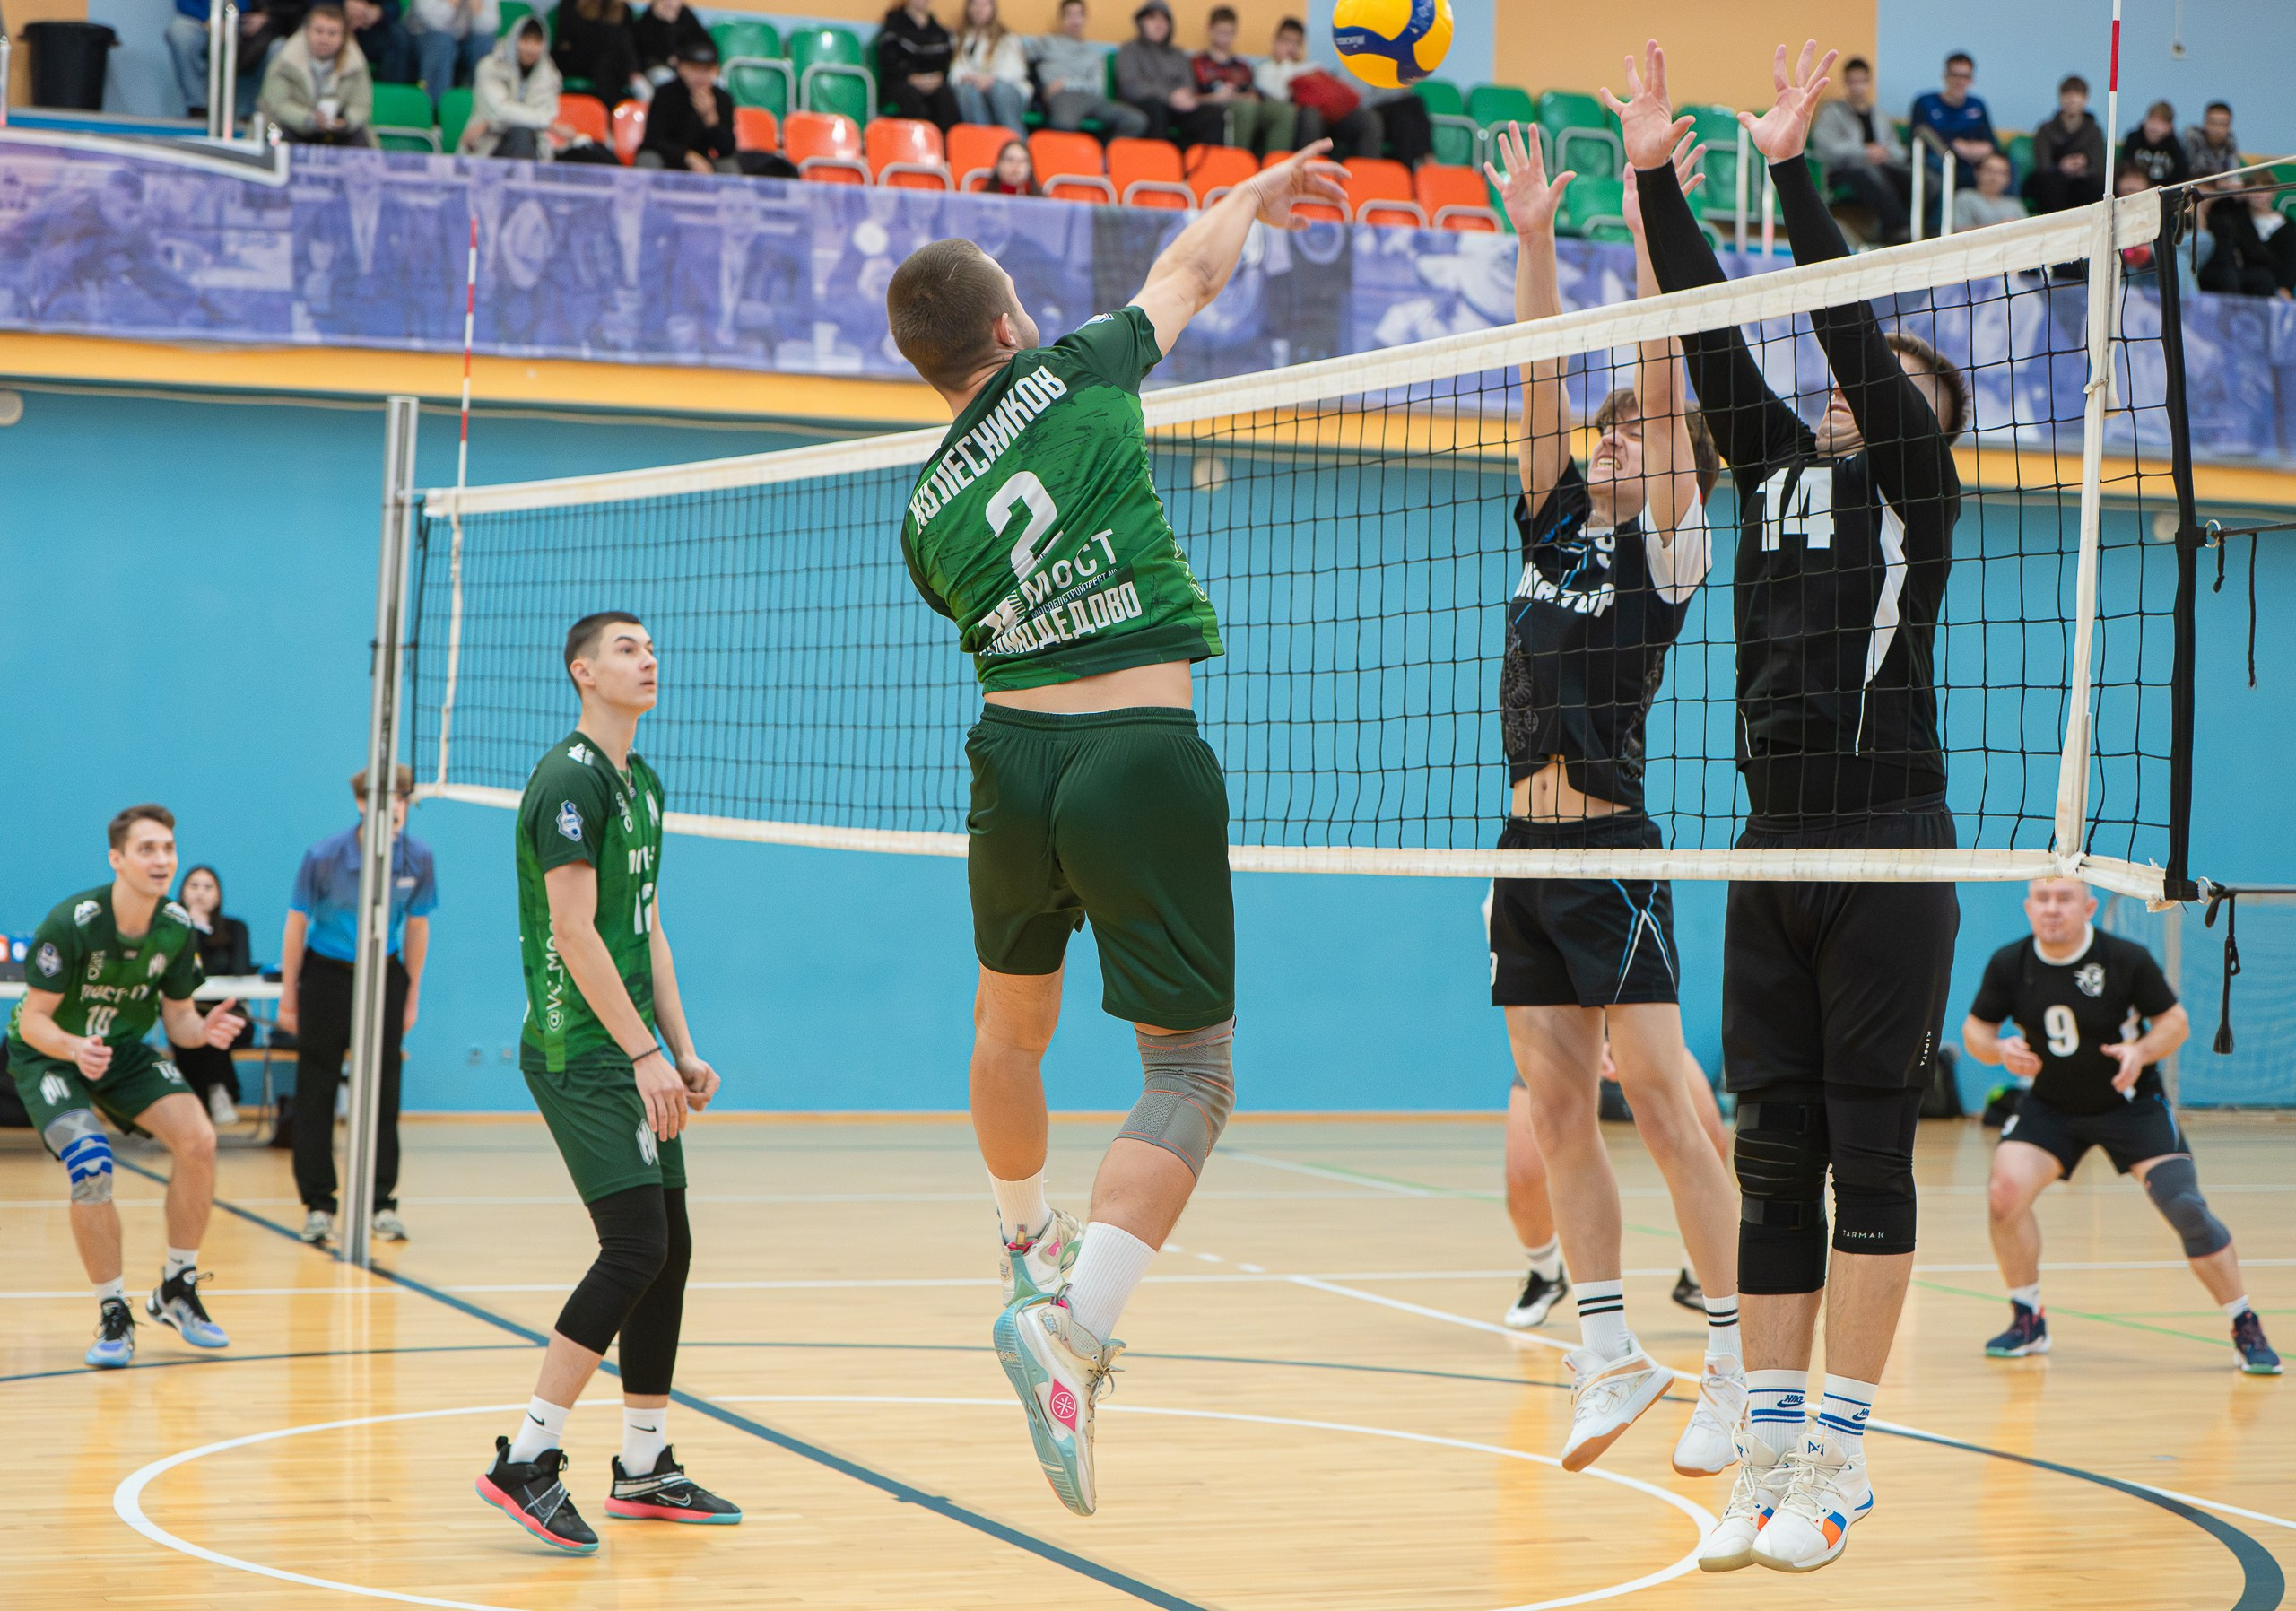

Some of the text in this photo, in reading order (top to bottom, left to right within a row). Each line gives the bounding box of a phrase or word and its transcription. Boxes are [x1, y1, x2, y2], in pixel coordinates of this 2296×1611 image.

[909, 365, 1067, 536] КОЛЕСНИКОВ
[986, 471, 1064, 584] 2
[1755, 467, 1835, 552] 14
[1019, 528, 1117, 611] МОСТ
[2044, 1005, 2080, 1057] 9
[1843, 1229, 1884, 1239] TARMAK
